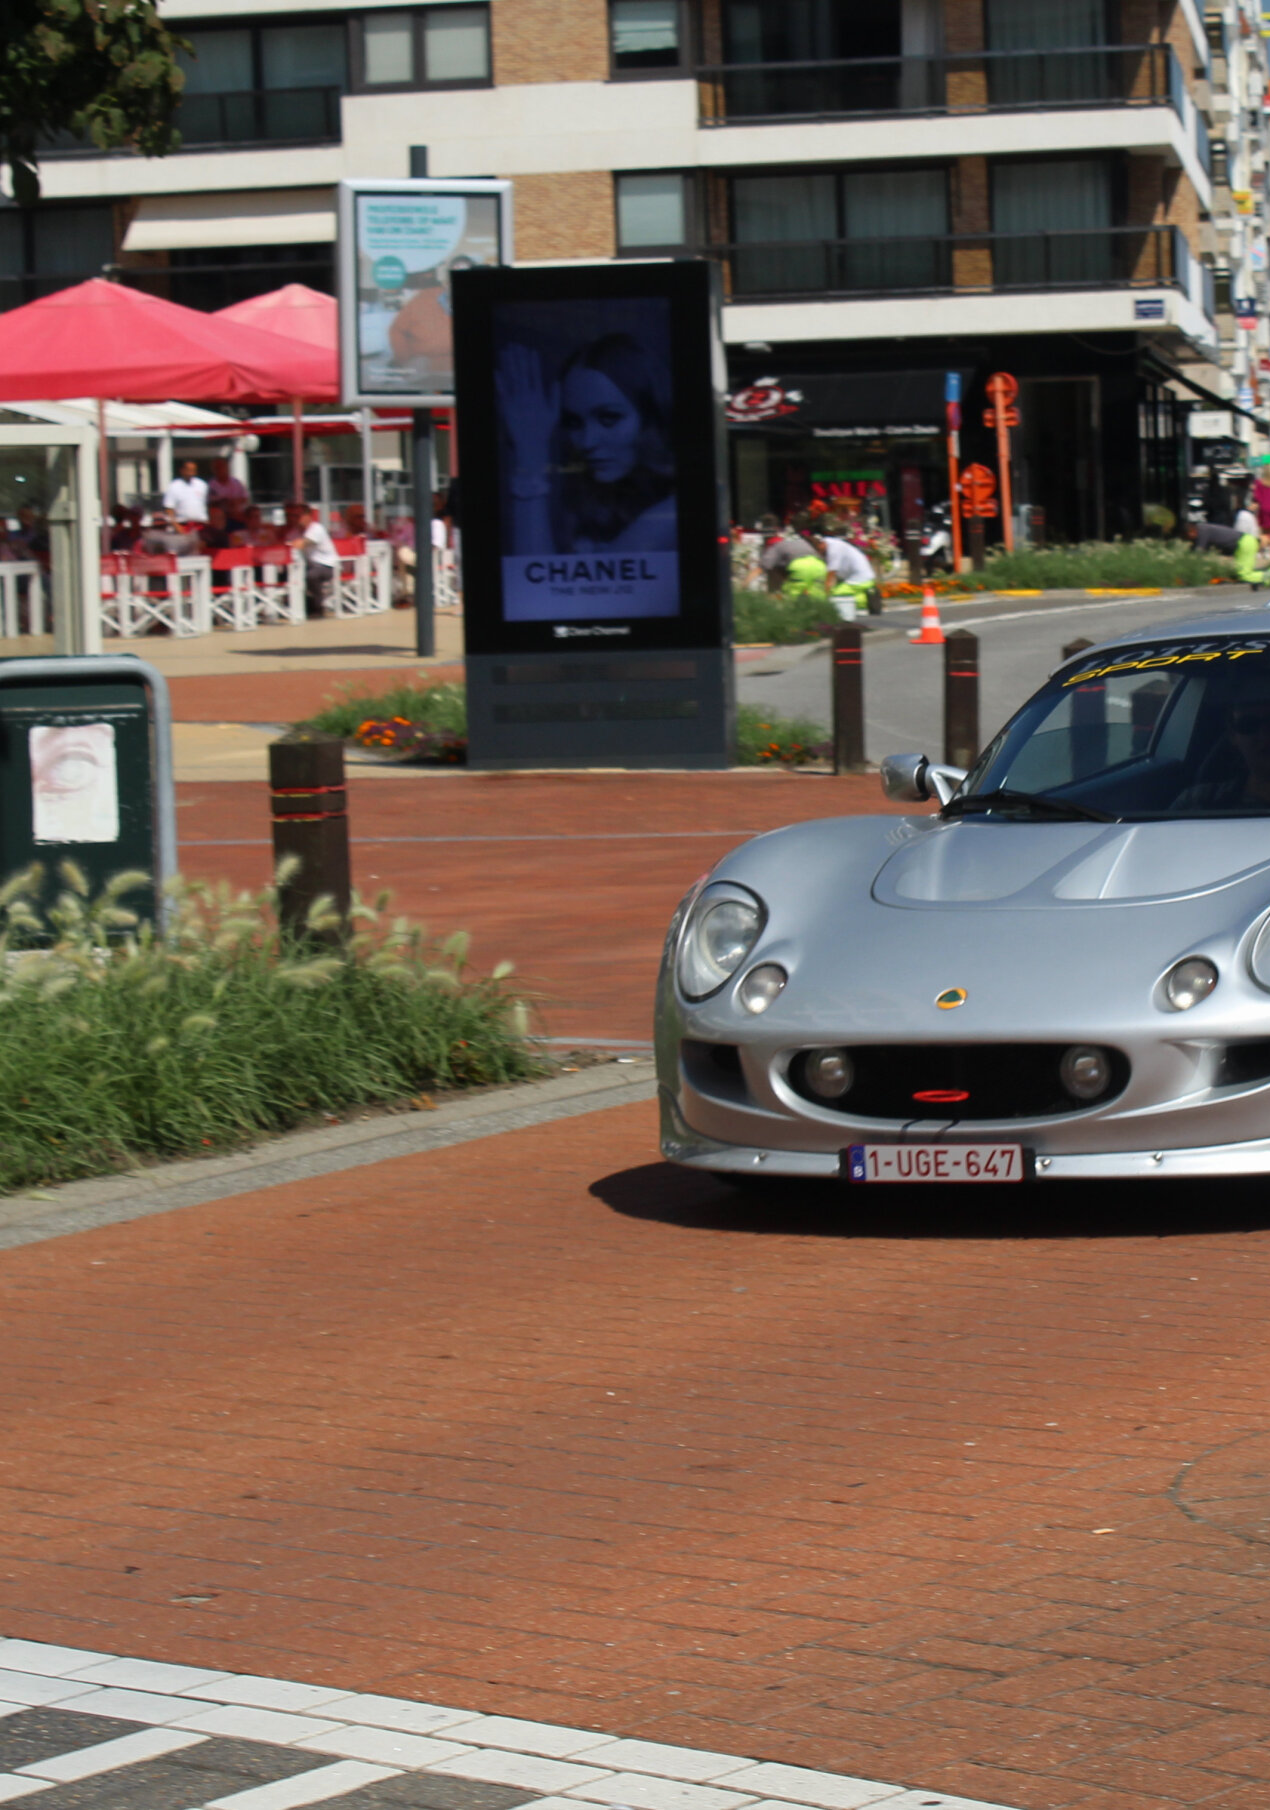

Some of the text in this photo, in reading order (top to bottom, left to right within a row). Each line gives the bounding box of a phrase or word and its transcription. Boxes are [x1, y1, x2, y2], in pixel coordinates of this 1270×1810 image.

[524, 558, 657, 584] CHANEL
[1062, 649, 1263, 687] SPORT
[868, 1149, 1016, 1178] 1-UGE-647
